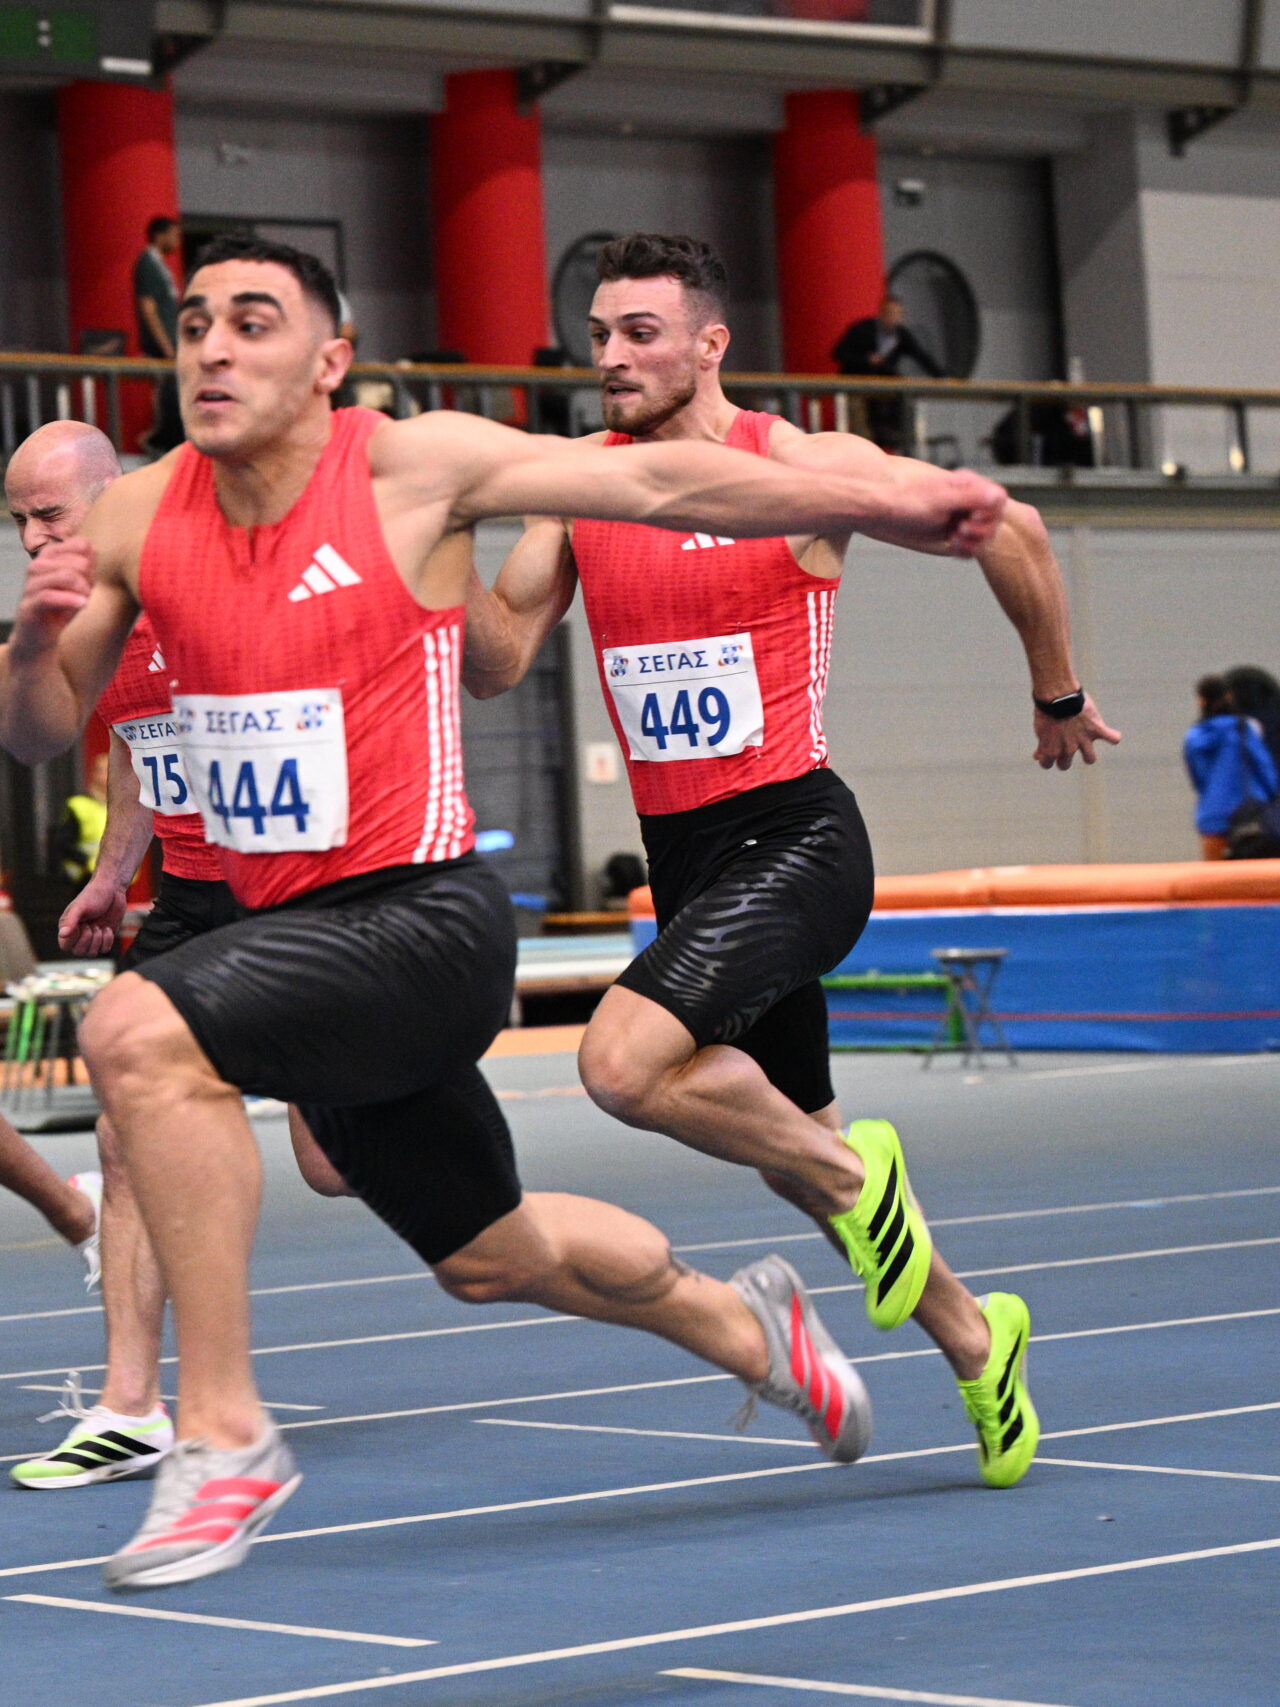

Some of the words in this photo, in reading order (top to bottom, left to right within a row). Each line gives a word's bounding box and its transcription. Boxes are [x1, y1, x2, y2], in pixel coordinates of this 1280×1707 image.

[638, 650, 709, 674] ΣΕΓΑΣ
[205, 709, 284, 734] ΣΕΓΑΣ
[641, 686, 731, 750] 449
[139, 722, 178, 740] ΣΕΓΑ
[208, 759, 310, 836] 444
